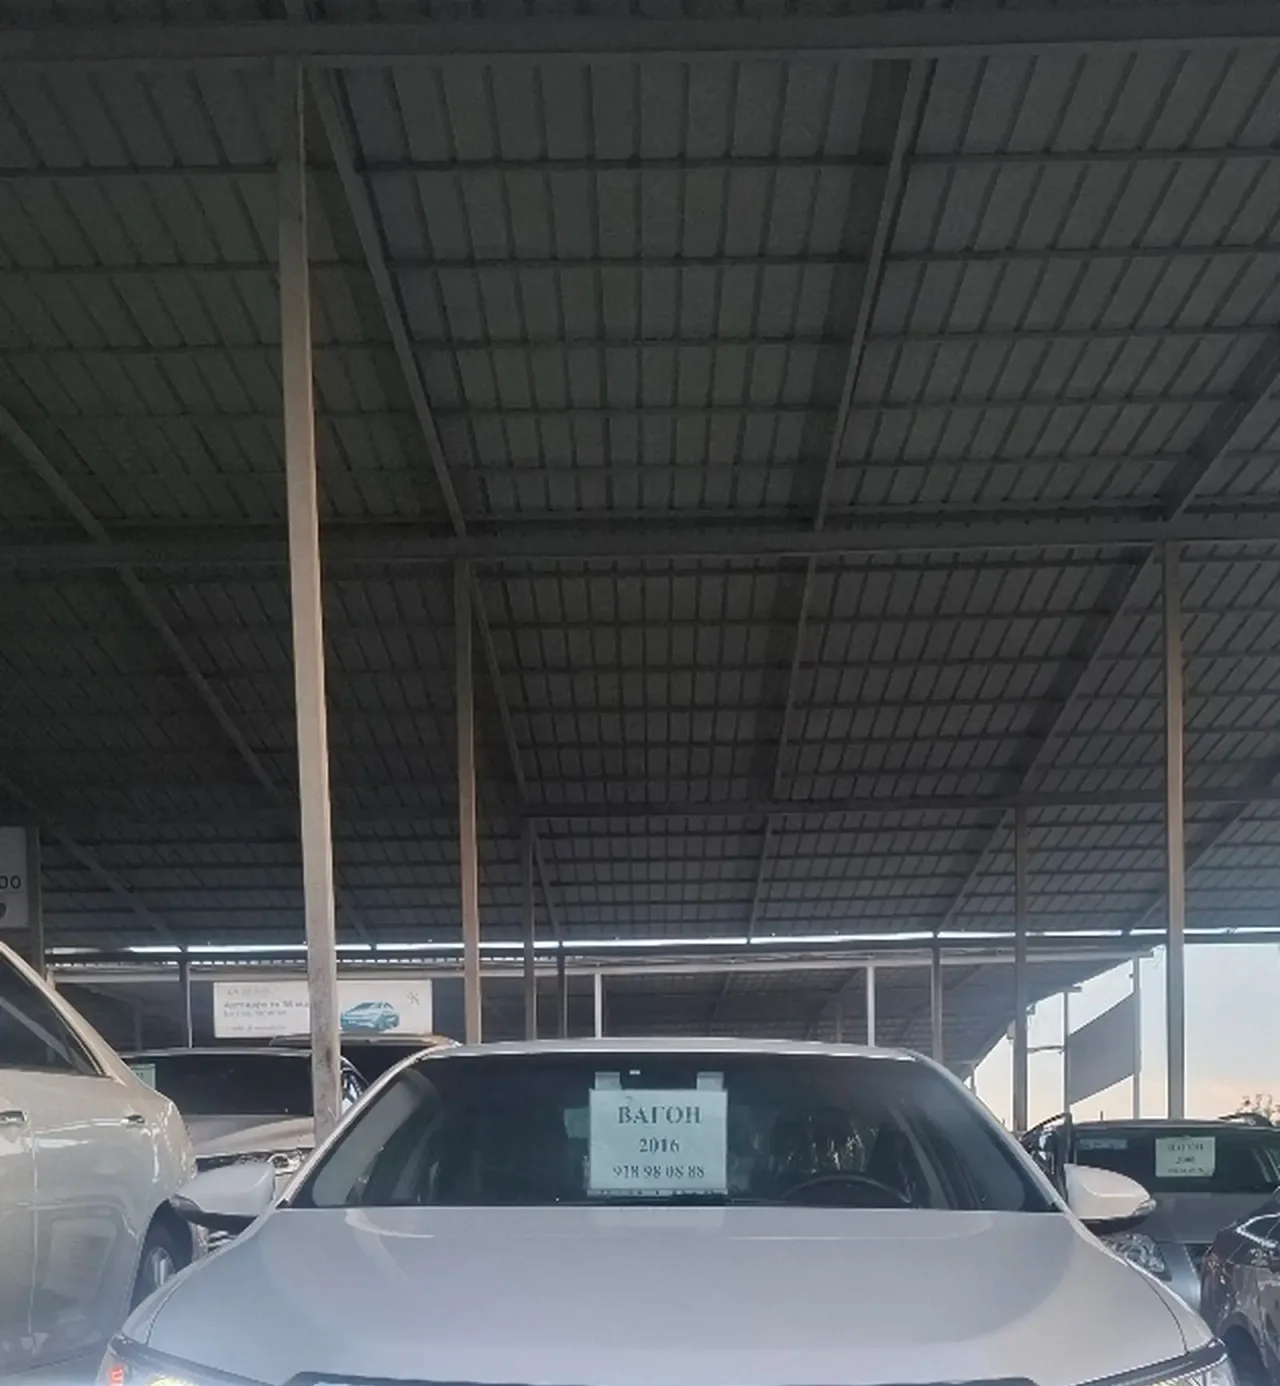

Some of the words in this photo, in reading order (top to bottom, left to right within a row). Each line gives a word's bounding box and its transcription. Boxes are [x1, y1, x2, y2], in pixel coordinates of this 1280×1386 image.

[618, 1106, 701, 1124] ВАГОН
[639, 1137, 680, 1153] 2016
[612, 1165, 639, 1179] 918
[643, 1165, 661, 1179] 98
[665, 1165, 684, 1179] 08
[688, 1165, 705, 1179] 88
